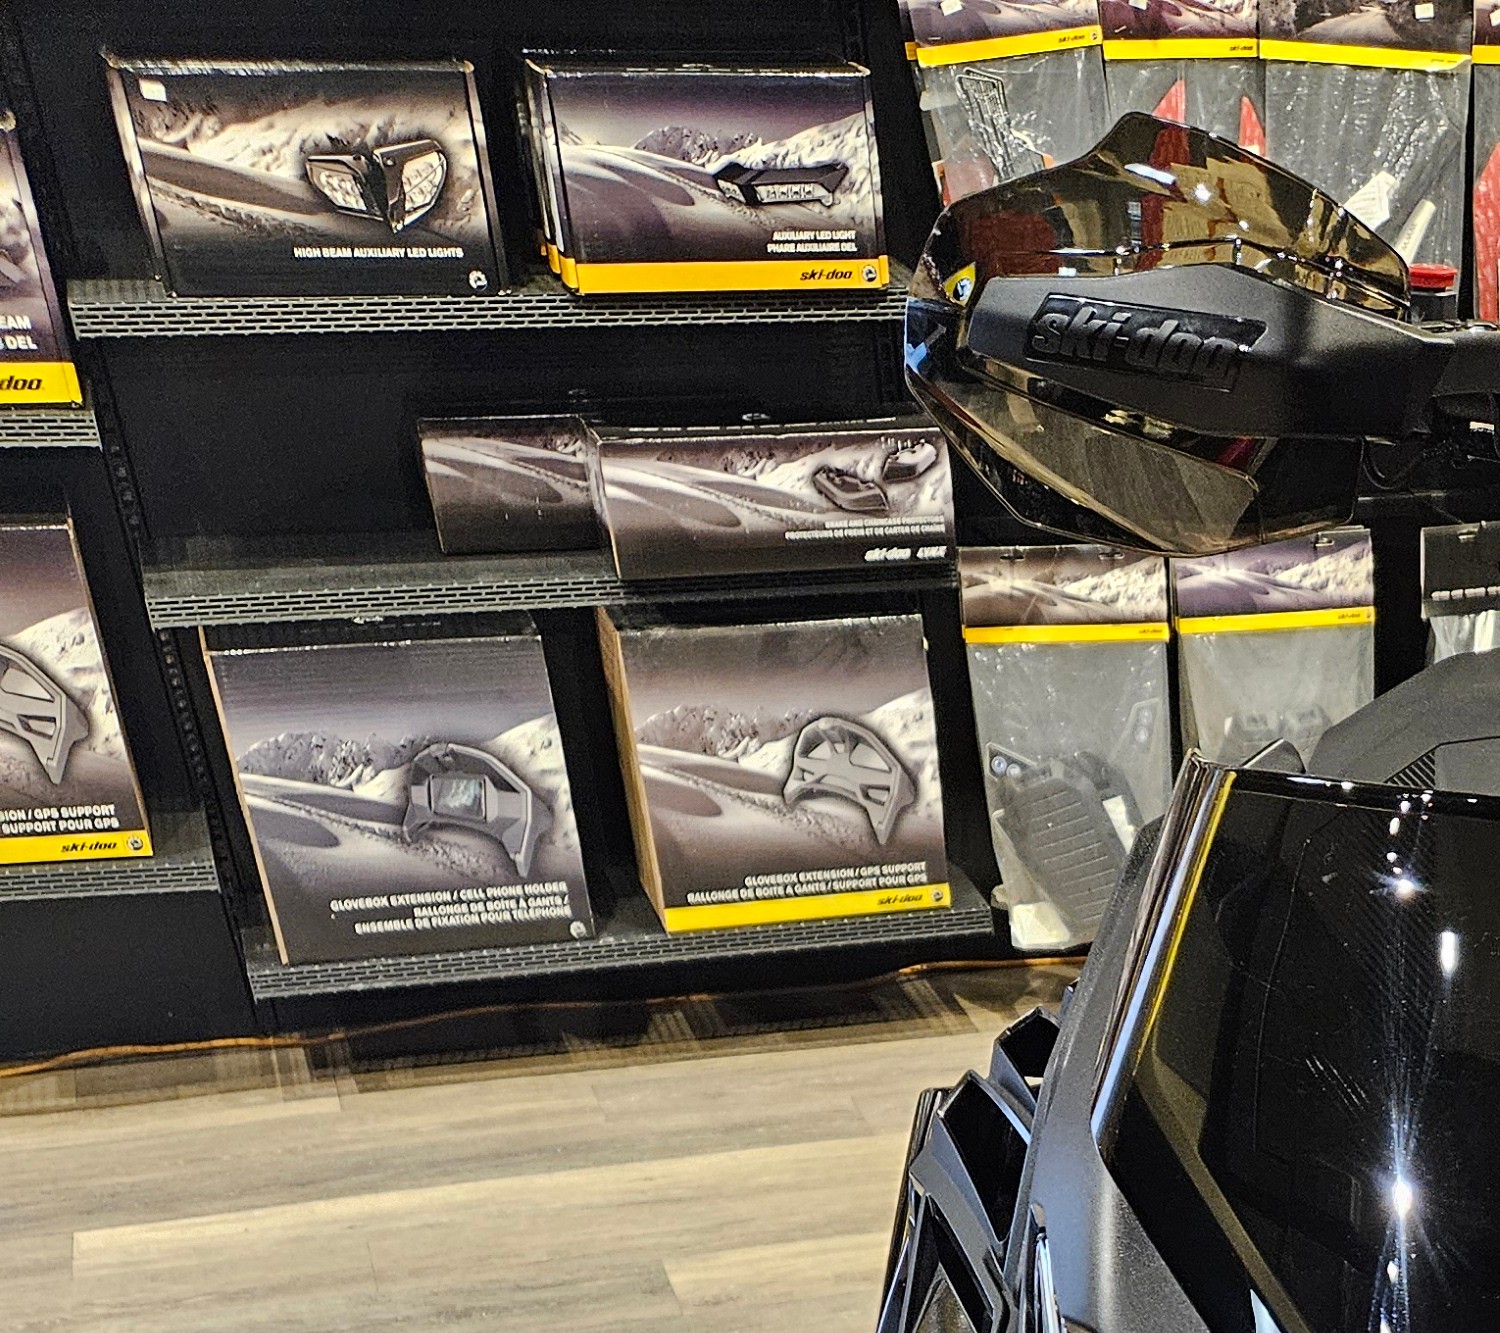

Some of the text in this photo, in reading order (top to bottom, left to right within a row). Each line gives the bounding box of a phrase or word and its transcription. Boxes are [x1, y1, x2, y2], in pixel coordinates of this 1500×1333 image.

[832, 230, 856, 240] LIGHT
[294, 247, 464, 258] HIGH BEAM AUXILIARY LED LIGHTS
[800, 269, 853, 281] ski-doo
[1032, 306, 1240, 378] ski-doo
[34, 807, 59, 819] GPS
[60, 804, 115, 819] SUPPORT
[2, 817, 119, 834] SUPPORT POUR GPS
[61, 841, 117, 853] ski-doo
[745, 872, 797, 888] GLOVEBOX
[799, 867, 855, 883] EXTENSION
[860, 865, 881, 877] GPS
[881, 861, 926, 875] SUPPORT
[330, 894, 389, 912] GLOVEBOX
[390, 889, 451, 907] EXTENSION
[459, 887, 485, 901] CELL
[486, 884, 523, 899] PHONE
[524, 881, 568, 896] HOLDER
[687, 889, 738, 906] RALLONGE
[739, 887, 754, 900] DE
[794, 881, 827, 895] GANTS
[832, 876, 878, 891] SUPPORT
[878, 873, 906, 888] POUR
[906, 872, 928, 885] GPS
[413, 902, 468, 919] RALLONGE
[470, 900, 485, 914] DE
[528, 894, 562, 909] GANTS
[877, 893, 924, 906] ski-doo
[354, 917, 413, 935] ENSEMBLE
[414, 915, 430, 930] DE
[431, 912, 480, 928] FIXATION
[481, 909, 511, 925] POUR
